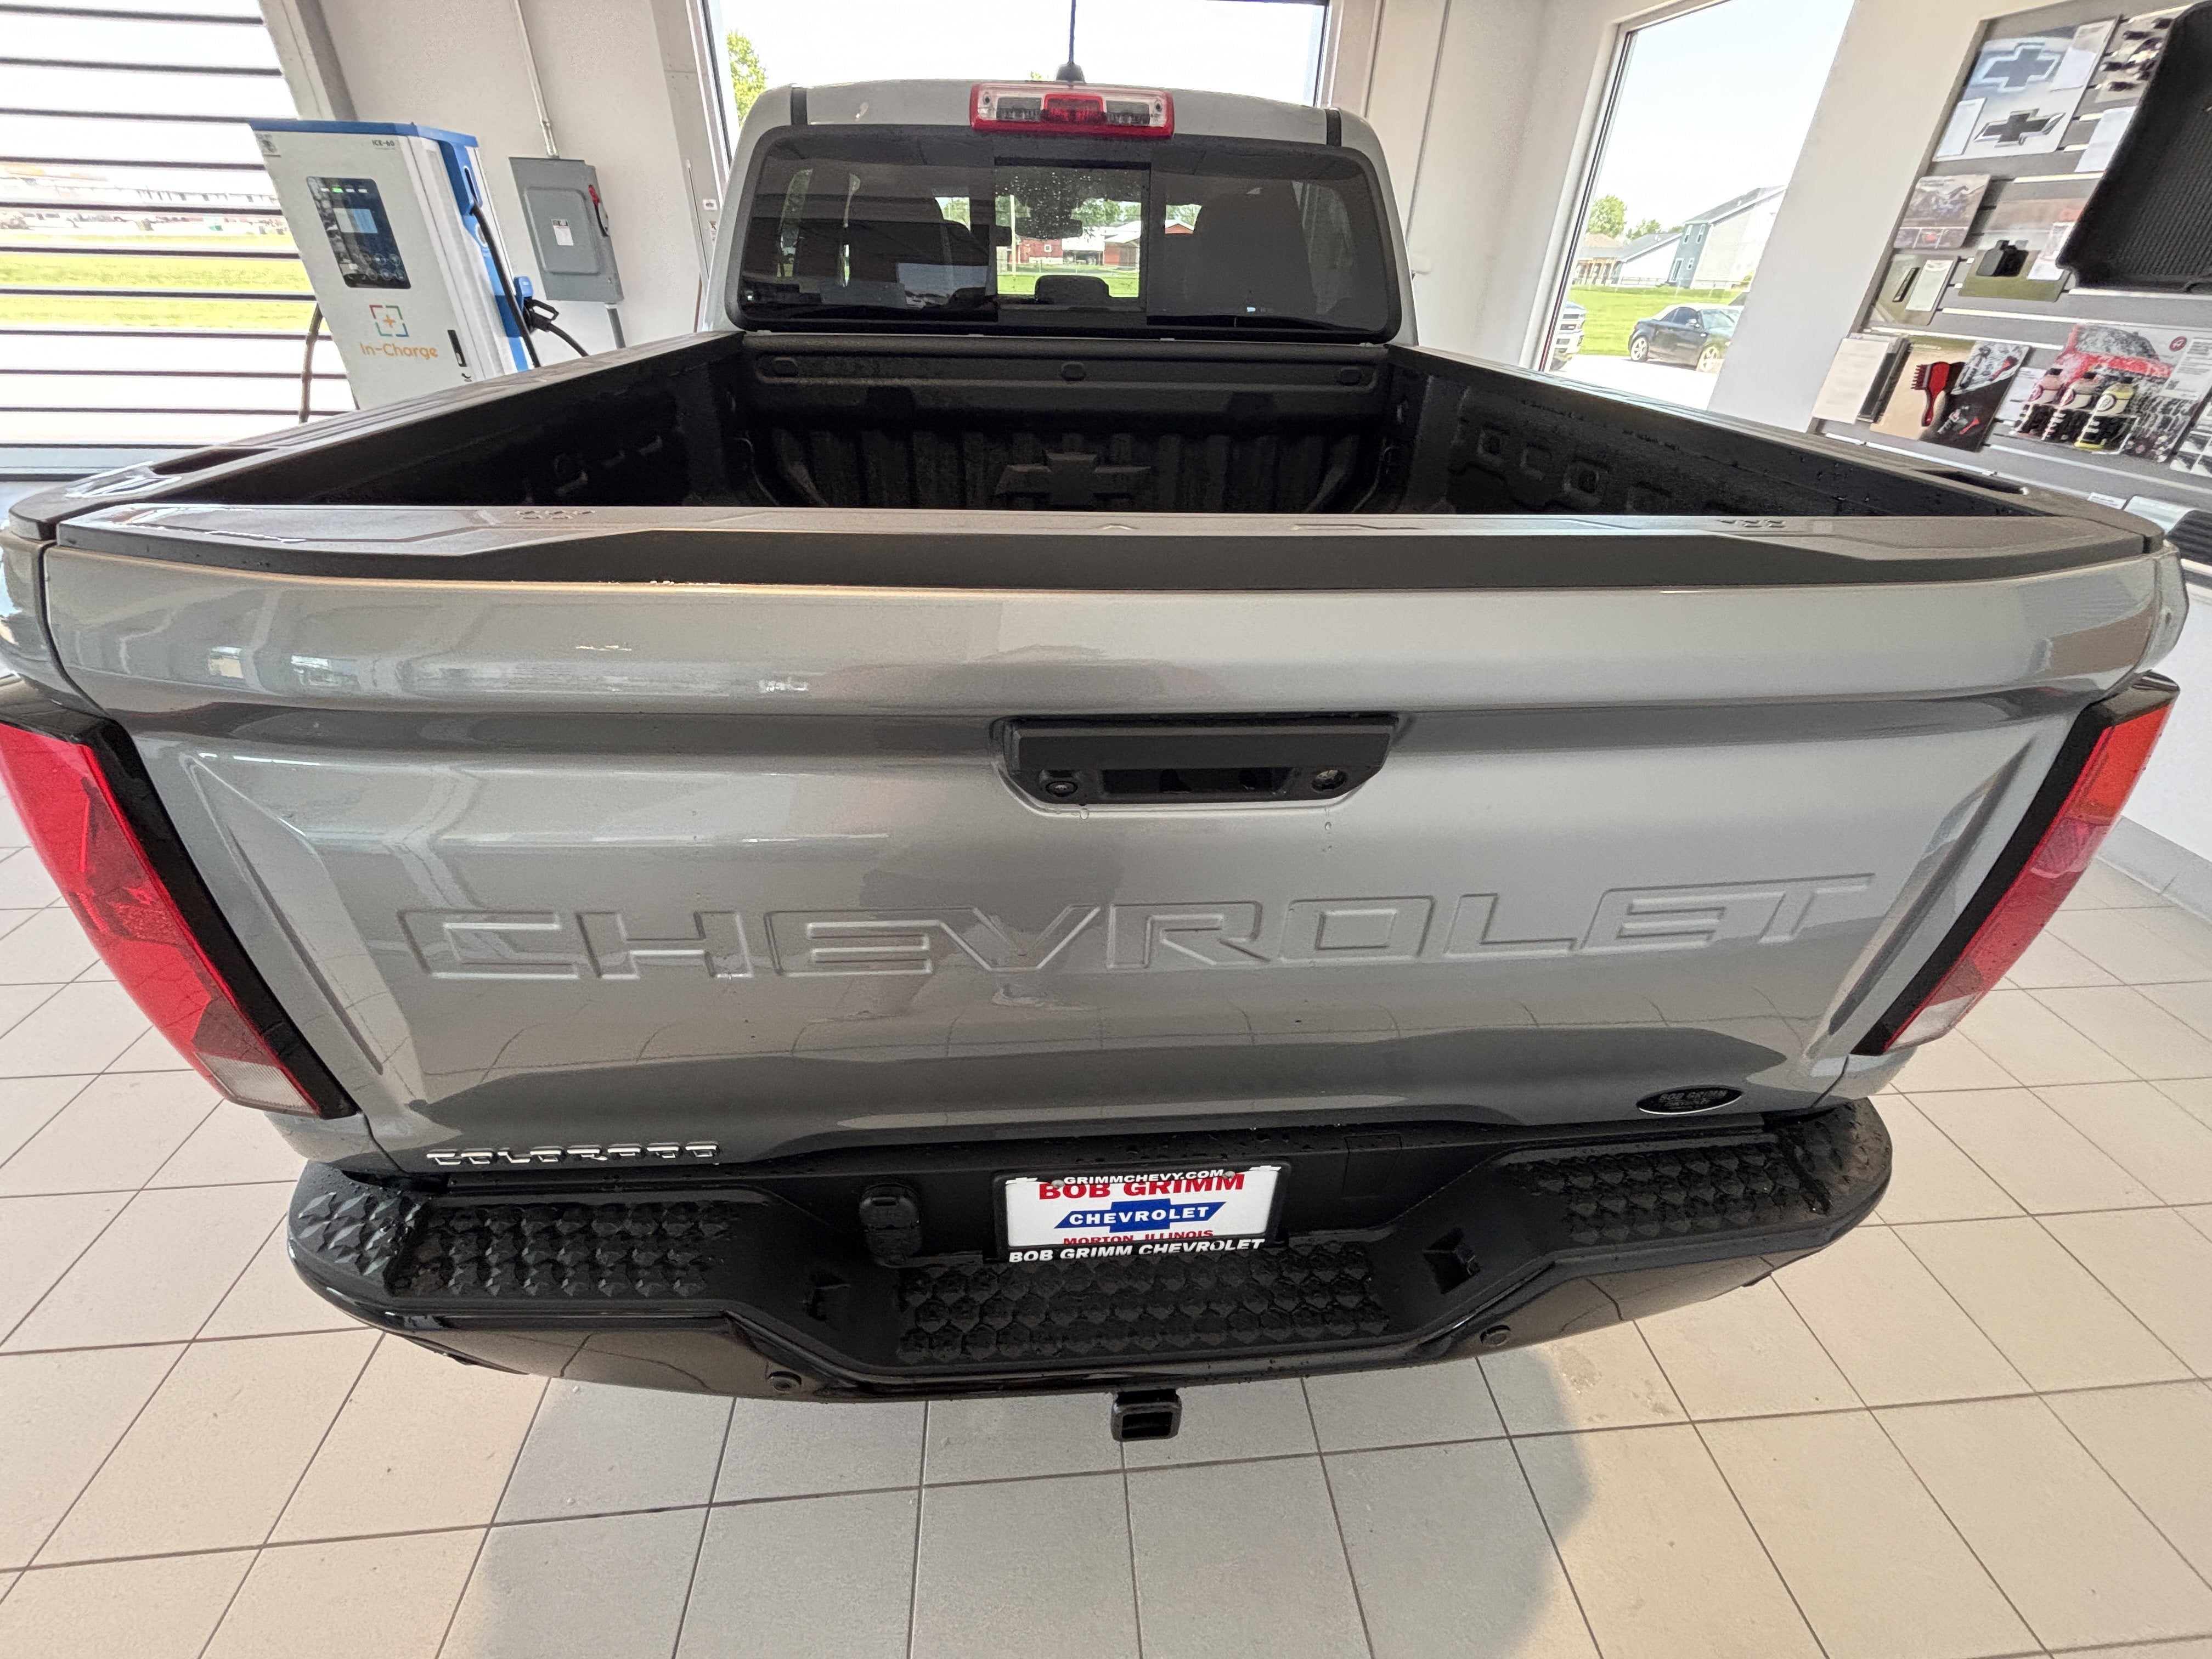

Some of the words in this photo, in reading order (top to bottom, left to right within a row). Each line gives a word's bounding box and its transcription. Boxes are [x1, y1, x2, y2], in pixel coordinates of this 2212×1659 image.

[359, 342, 439, 360] In-Charge
[397, 874, 1872, 979] CHEVROLET
[1063, 1169, 1224, 1184] GRIMMCHEVY.COM
[1039, 1182, 1110, 1200] BOB
[1123, 1173, 1245, 1196] GRIMM
[1069, 1206, 1209, 1225] CHEVROLET
[1063, 1235, 1134, 1245] MORTON
[1009, 1249, 1053, 1263] BOB
[1060, 1245, 1133, 1259] GRIMM
[1138, 1238, 1266, 1255] CHEVROLET
